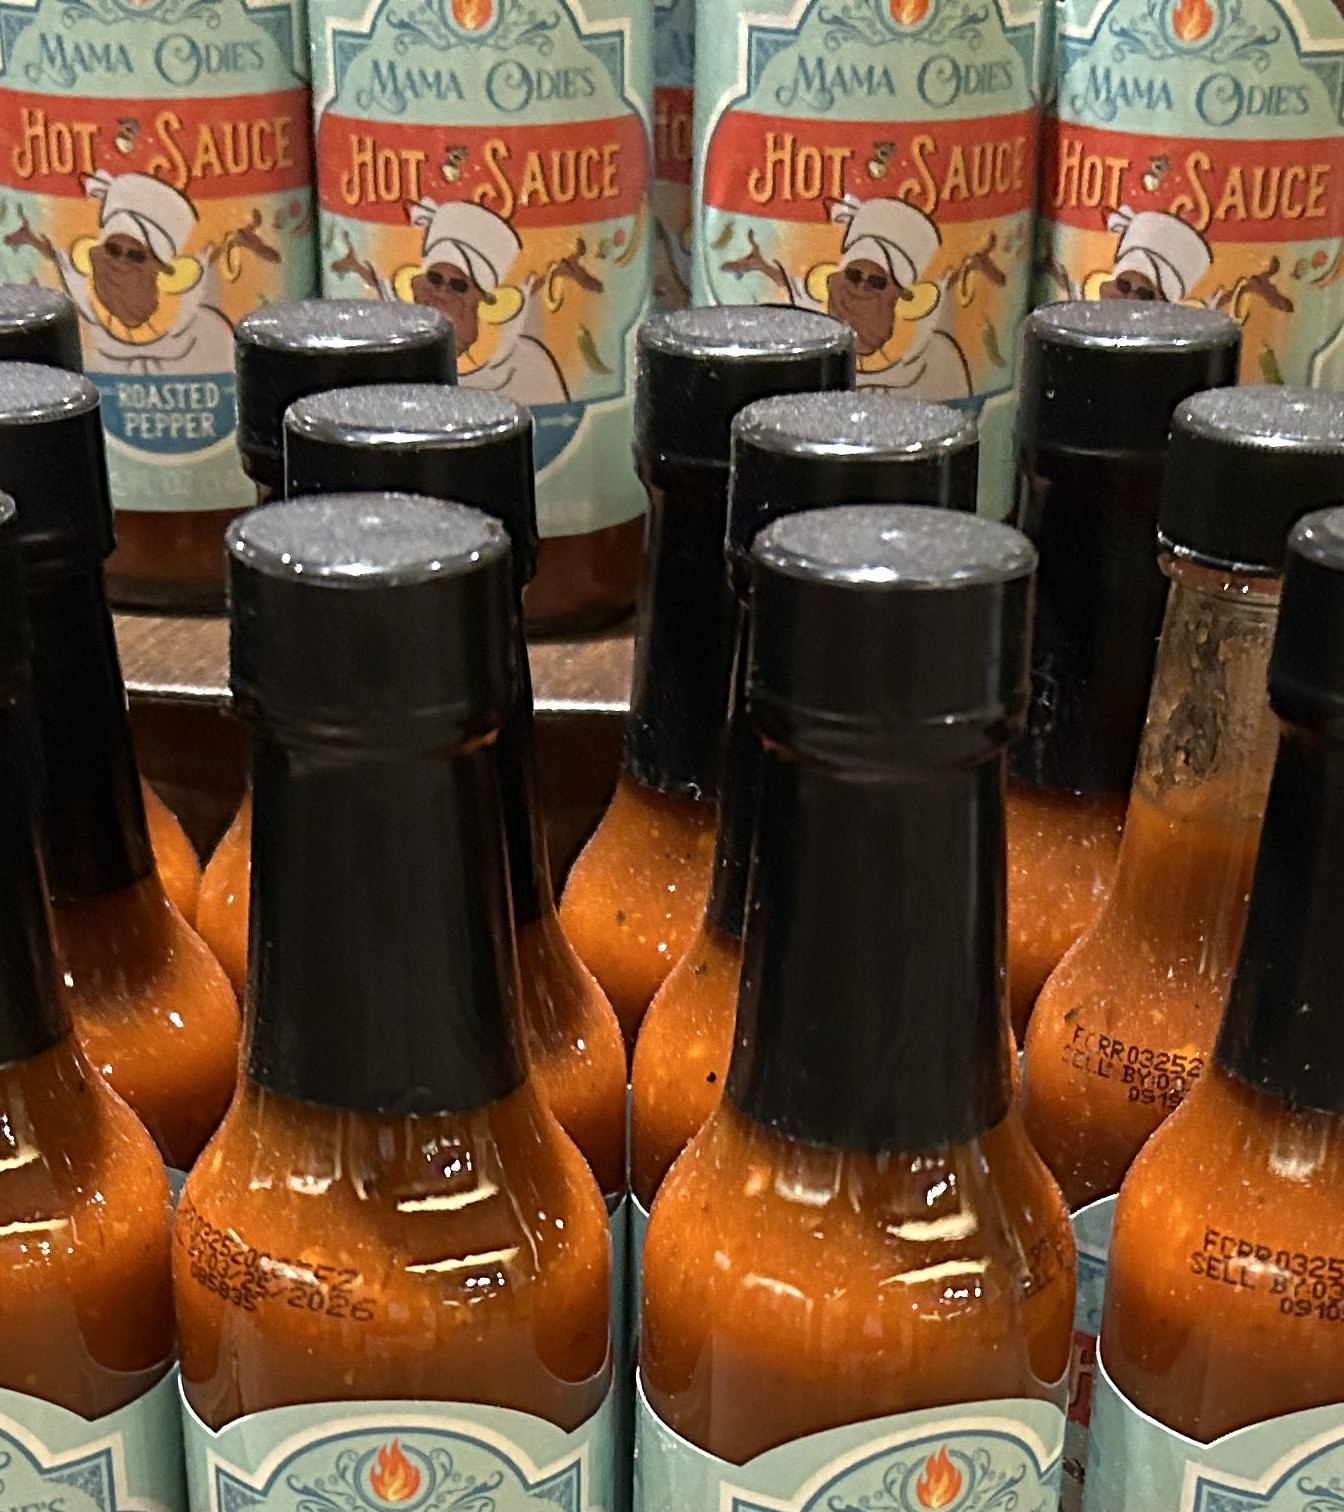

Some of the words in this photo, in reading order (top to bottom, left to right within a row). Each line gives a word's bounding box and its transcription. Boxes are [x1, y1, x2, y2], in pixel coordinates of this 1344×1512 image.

[25, 32, 135, 88] MAMA
[357, 60, 464, 114] MAMA
[775, 55, 896, 112] MAMA
[1071, 64, 1174, 122] MAMA
[13, 106, 101, 179] HOT
[149, 110, 294, 191] SAUCE
[340, 134, 428, 205] HOT
[472, 137, 622, 220] SAUCE
[747, 131, 853, 205] HOT
[898, 134, 1027, 216] SAUCE
[1055, 139, 1131, 210] HOT
[1169, 150, 1331, 233] SAUCE
[118, 381, 220, 411] ROASTED
[124, 410, 216, 440] PEPPER
[1189, 1250, 1256, 1292] SELL
